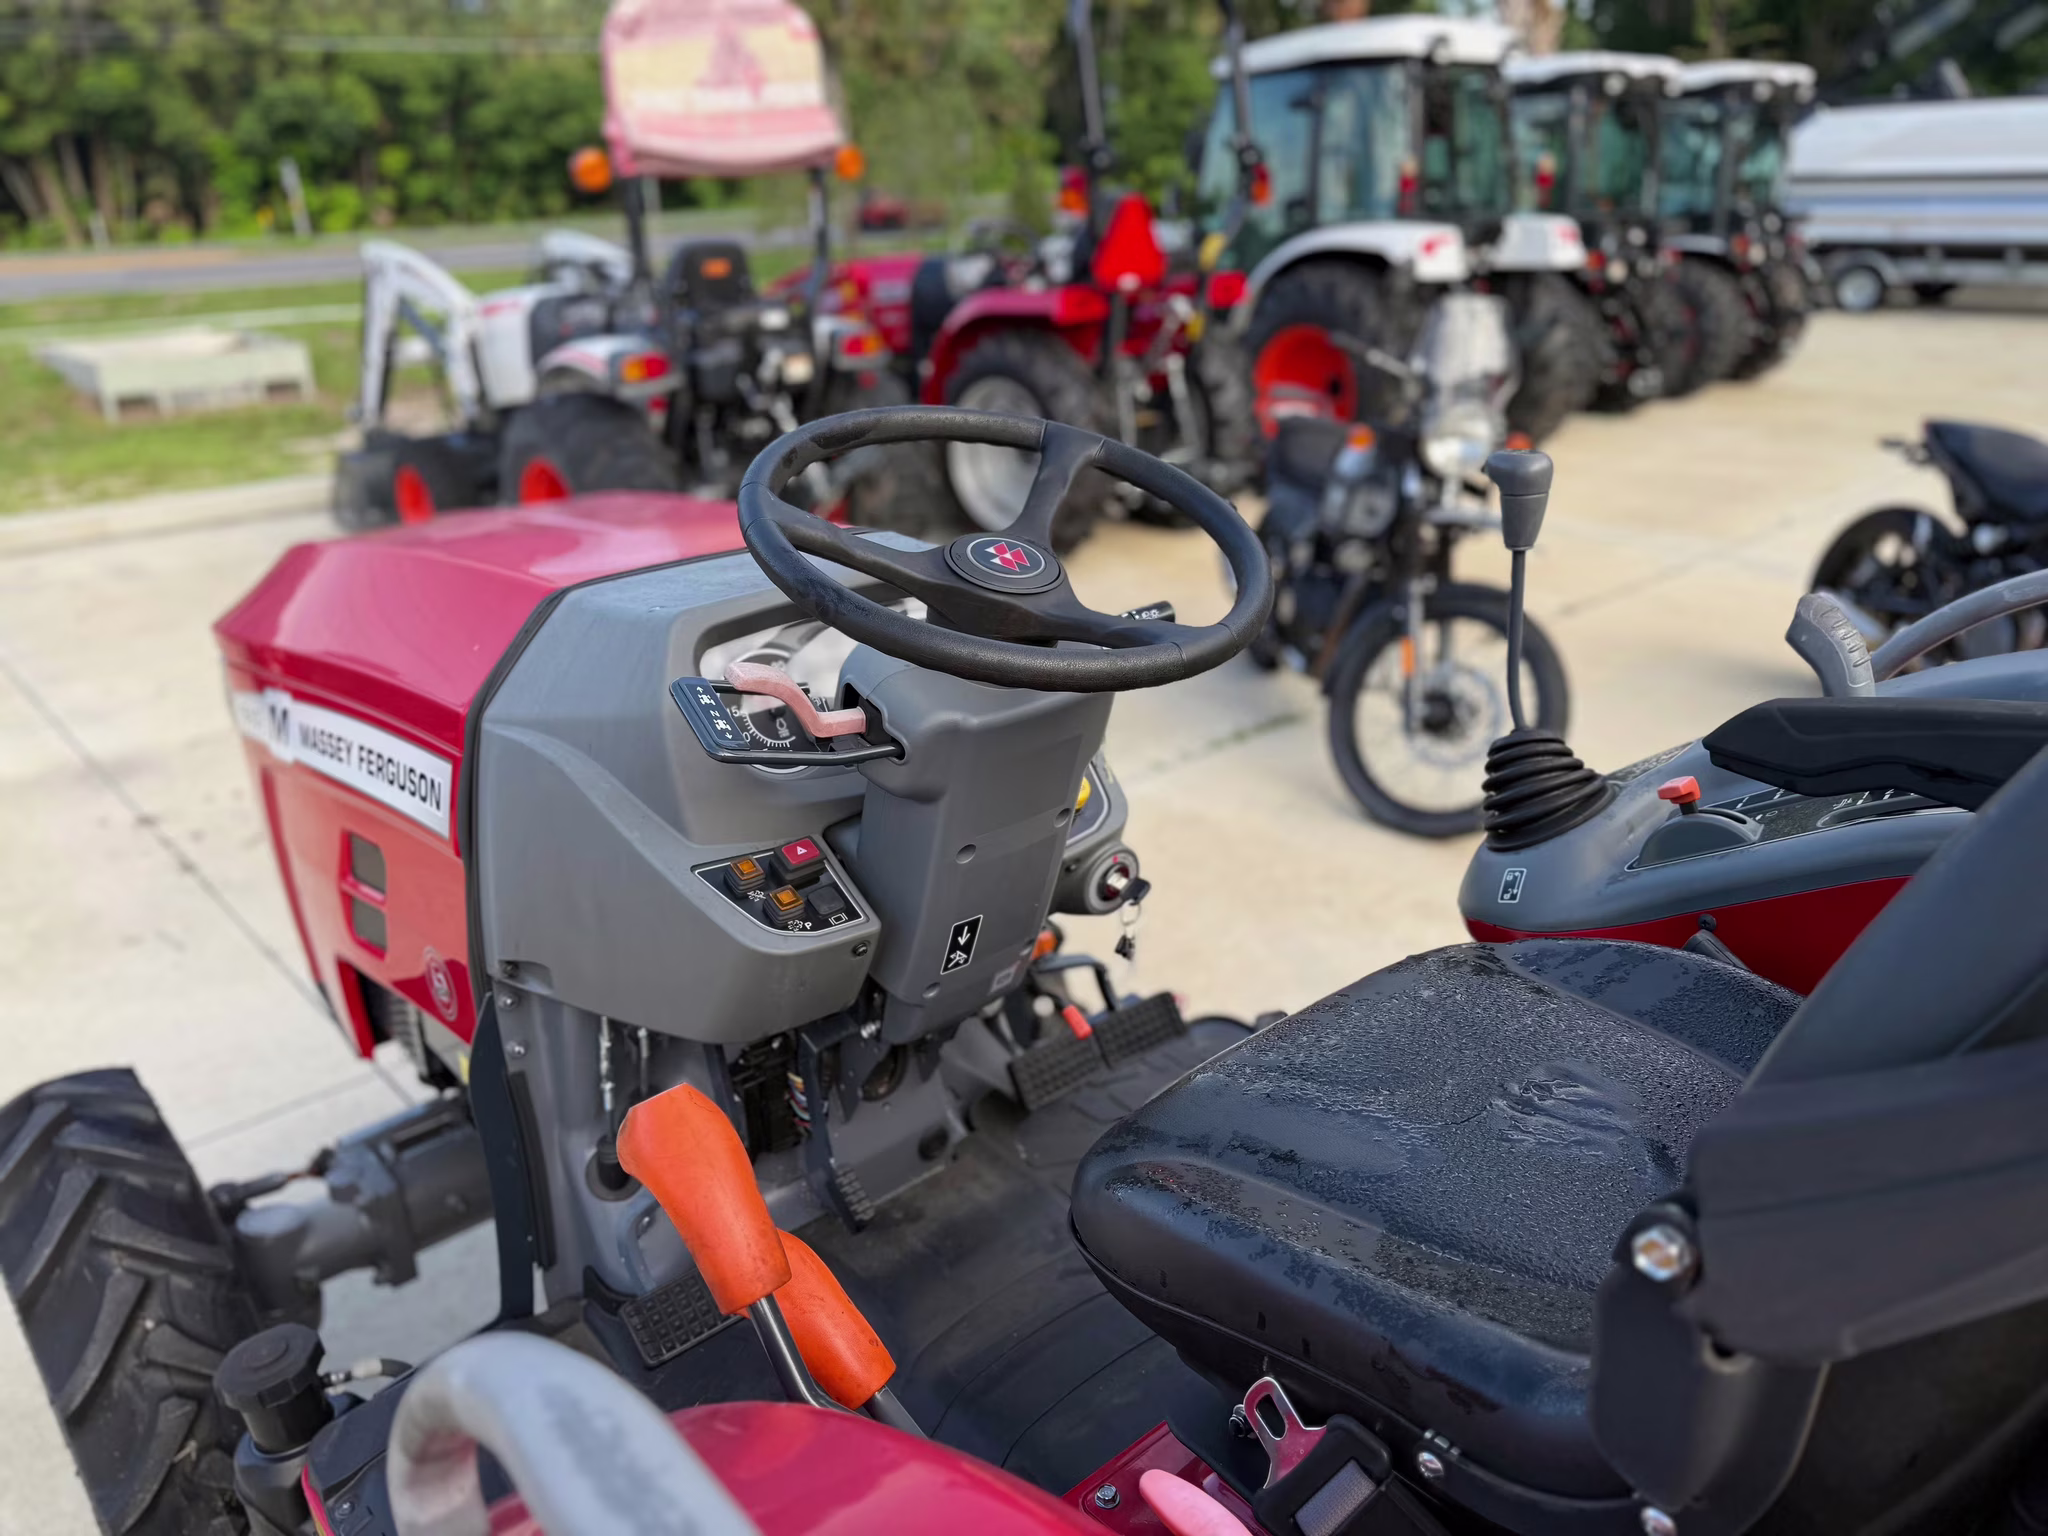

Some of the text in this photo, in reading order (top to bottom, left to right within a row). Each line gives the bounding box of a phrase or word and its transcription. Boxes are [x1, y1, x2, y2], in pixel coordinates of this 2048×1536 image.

[299, 722, 441, 811] MASSEY FERGUSON
[804, 922, 812, 930] P
